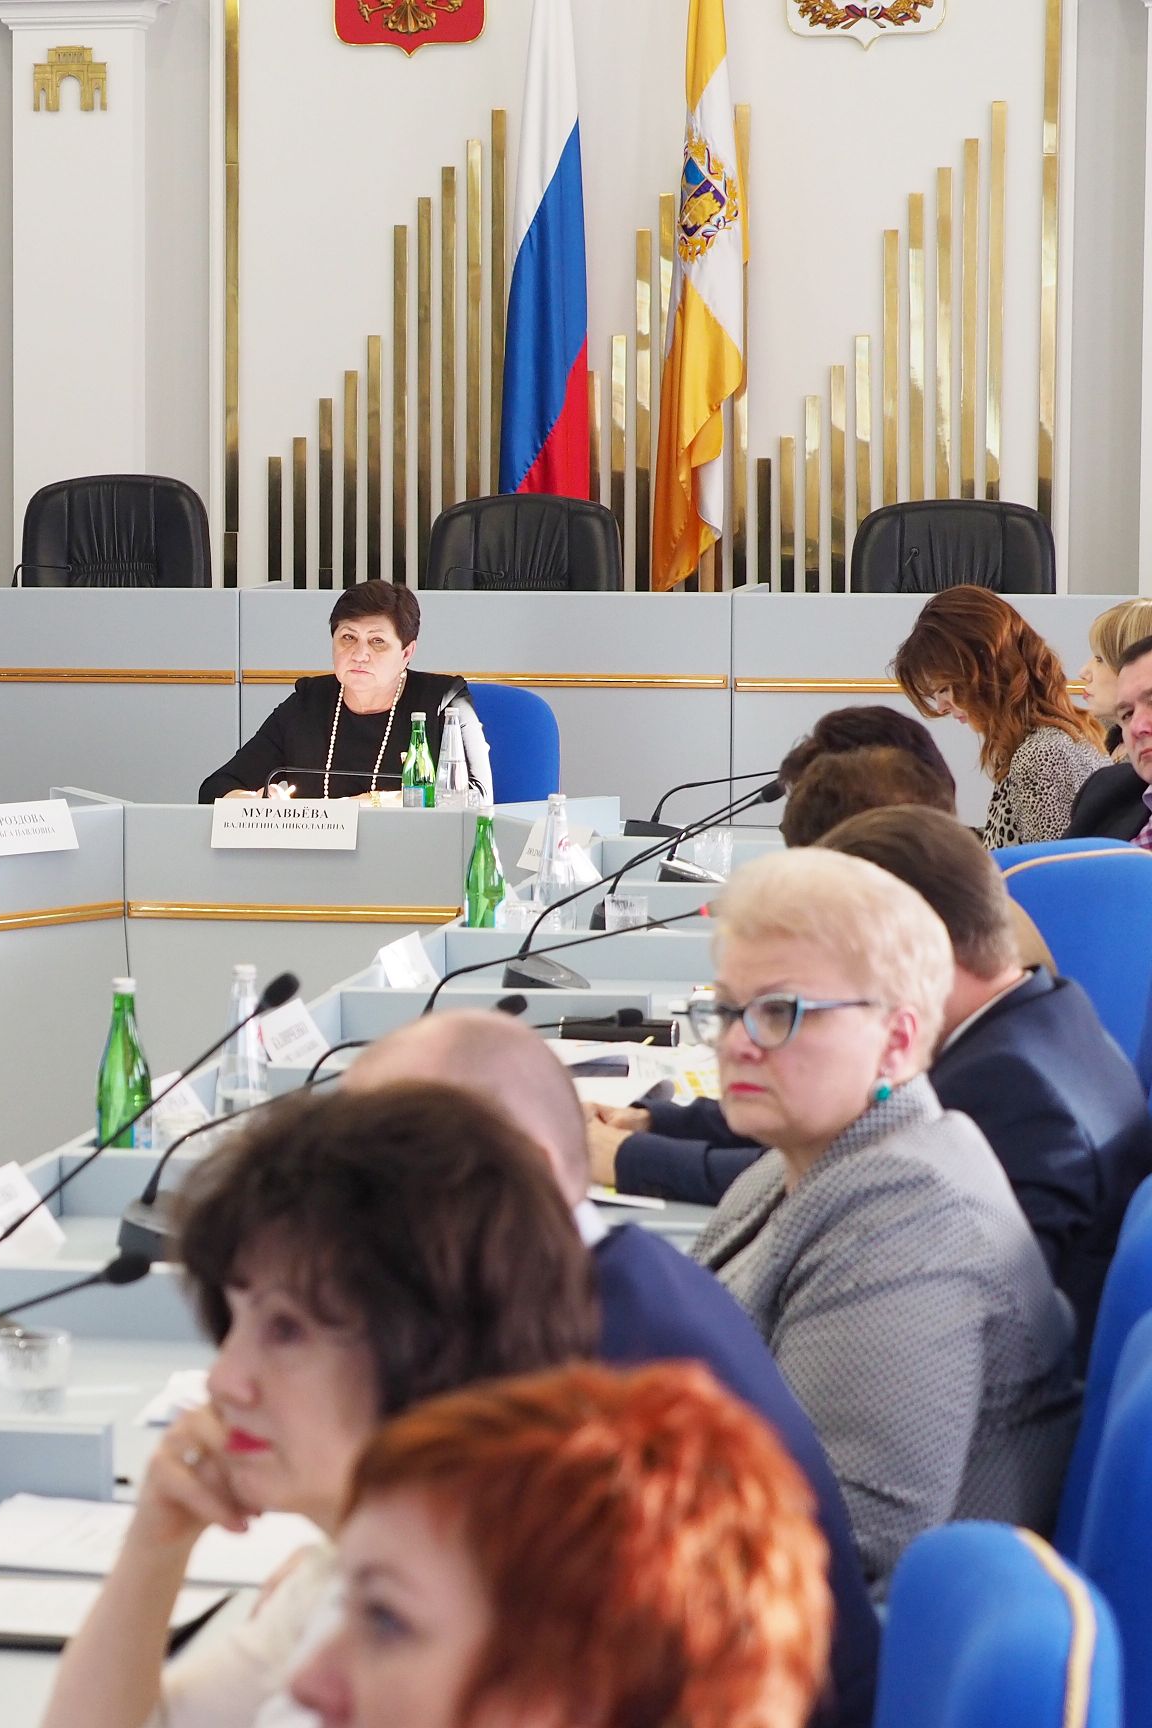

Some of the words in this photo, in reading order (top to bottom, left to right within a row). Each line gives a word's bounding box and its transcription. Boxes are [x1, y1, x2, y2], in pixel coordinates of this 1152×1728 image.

[242, 805, 329, 819] МУРАВЬЁВА
[223, 821, 279, 829] ВАЛЕНТИНА
[281, 822, 345, 831] НИКОЛАЕВНА
